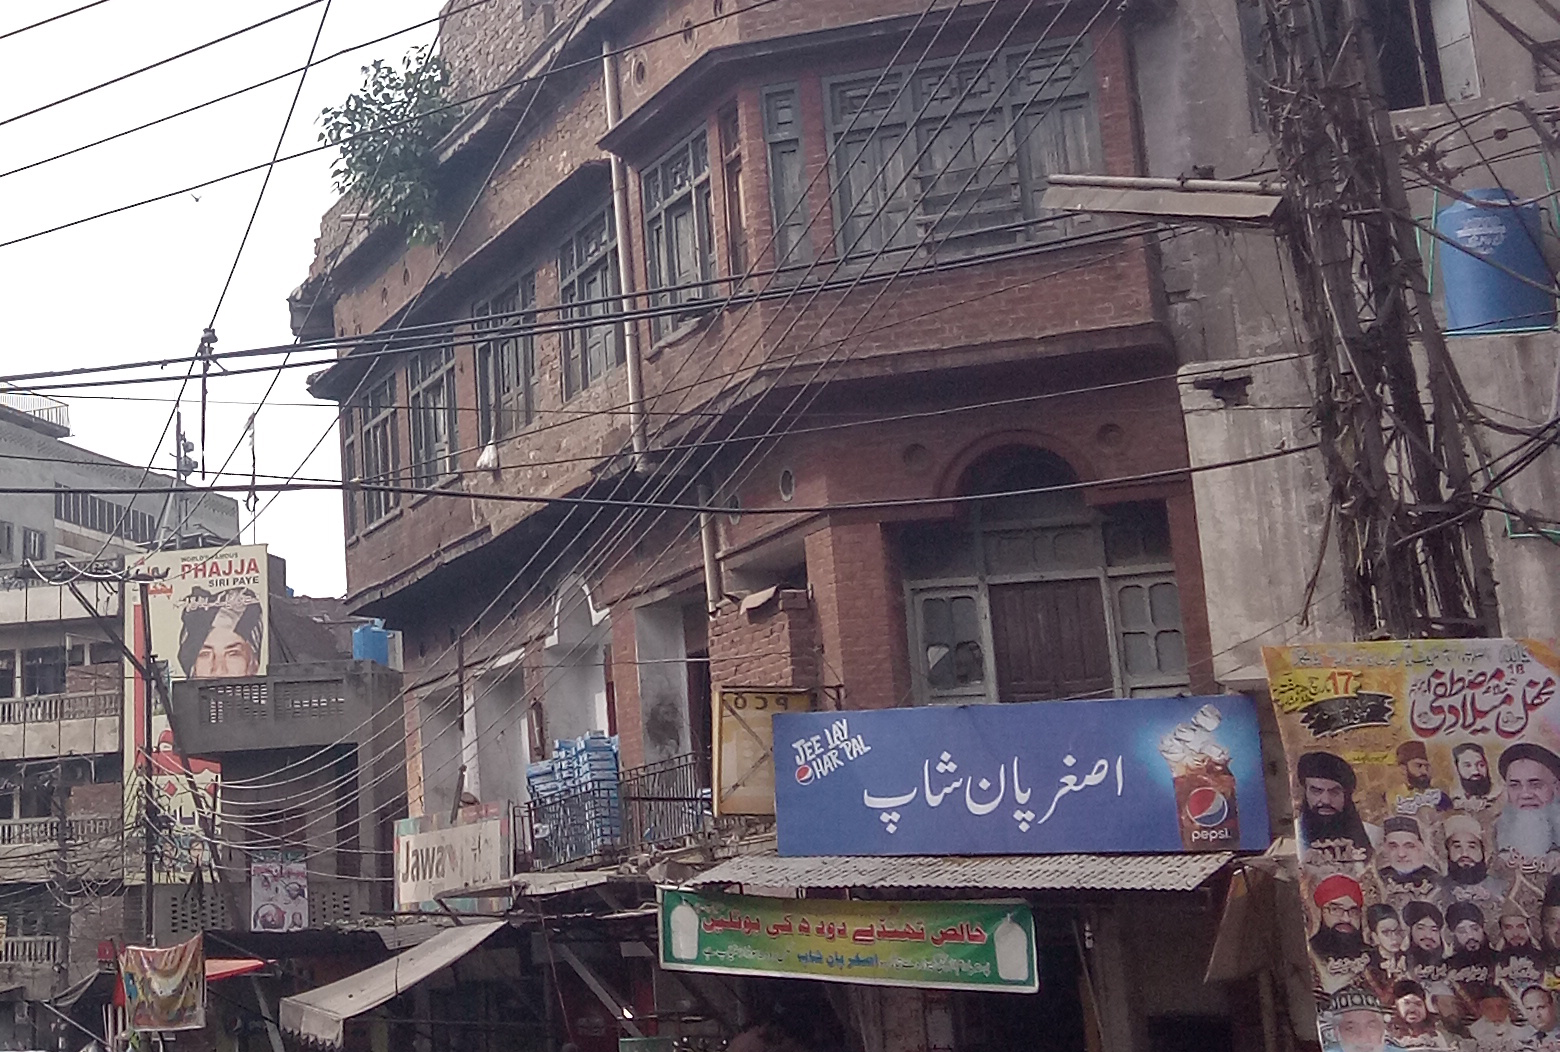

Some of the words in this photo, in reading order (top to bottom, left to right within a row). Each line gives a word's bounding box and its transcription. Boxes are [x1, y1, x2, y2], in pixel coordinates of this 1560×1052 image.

[180, 557, 260, 580] PHAJJA
[208, 577, 230, 588] SIRI
[233, 575, 260, 586] PAYE
[1326, 670, 1354, 696] 17
[791, 735, 825, 766] JEE
[823, 718, 849, 749] LAY
[812, 749, 845, 779] HAR
[839, 734, 872, 760] PAL
[862, 750, 964, 835] شاپ
[965, 755, 1037, 833] پان
[1037, 754, 1123, 825] اصغر
[1191, 827, 1230, 842] pepsi
[401, 840, 446, 884] Jawa
[765, 912, 794, 939] کی
[930, 922, 988, 947] خالص
